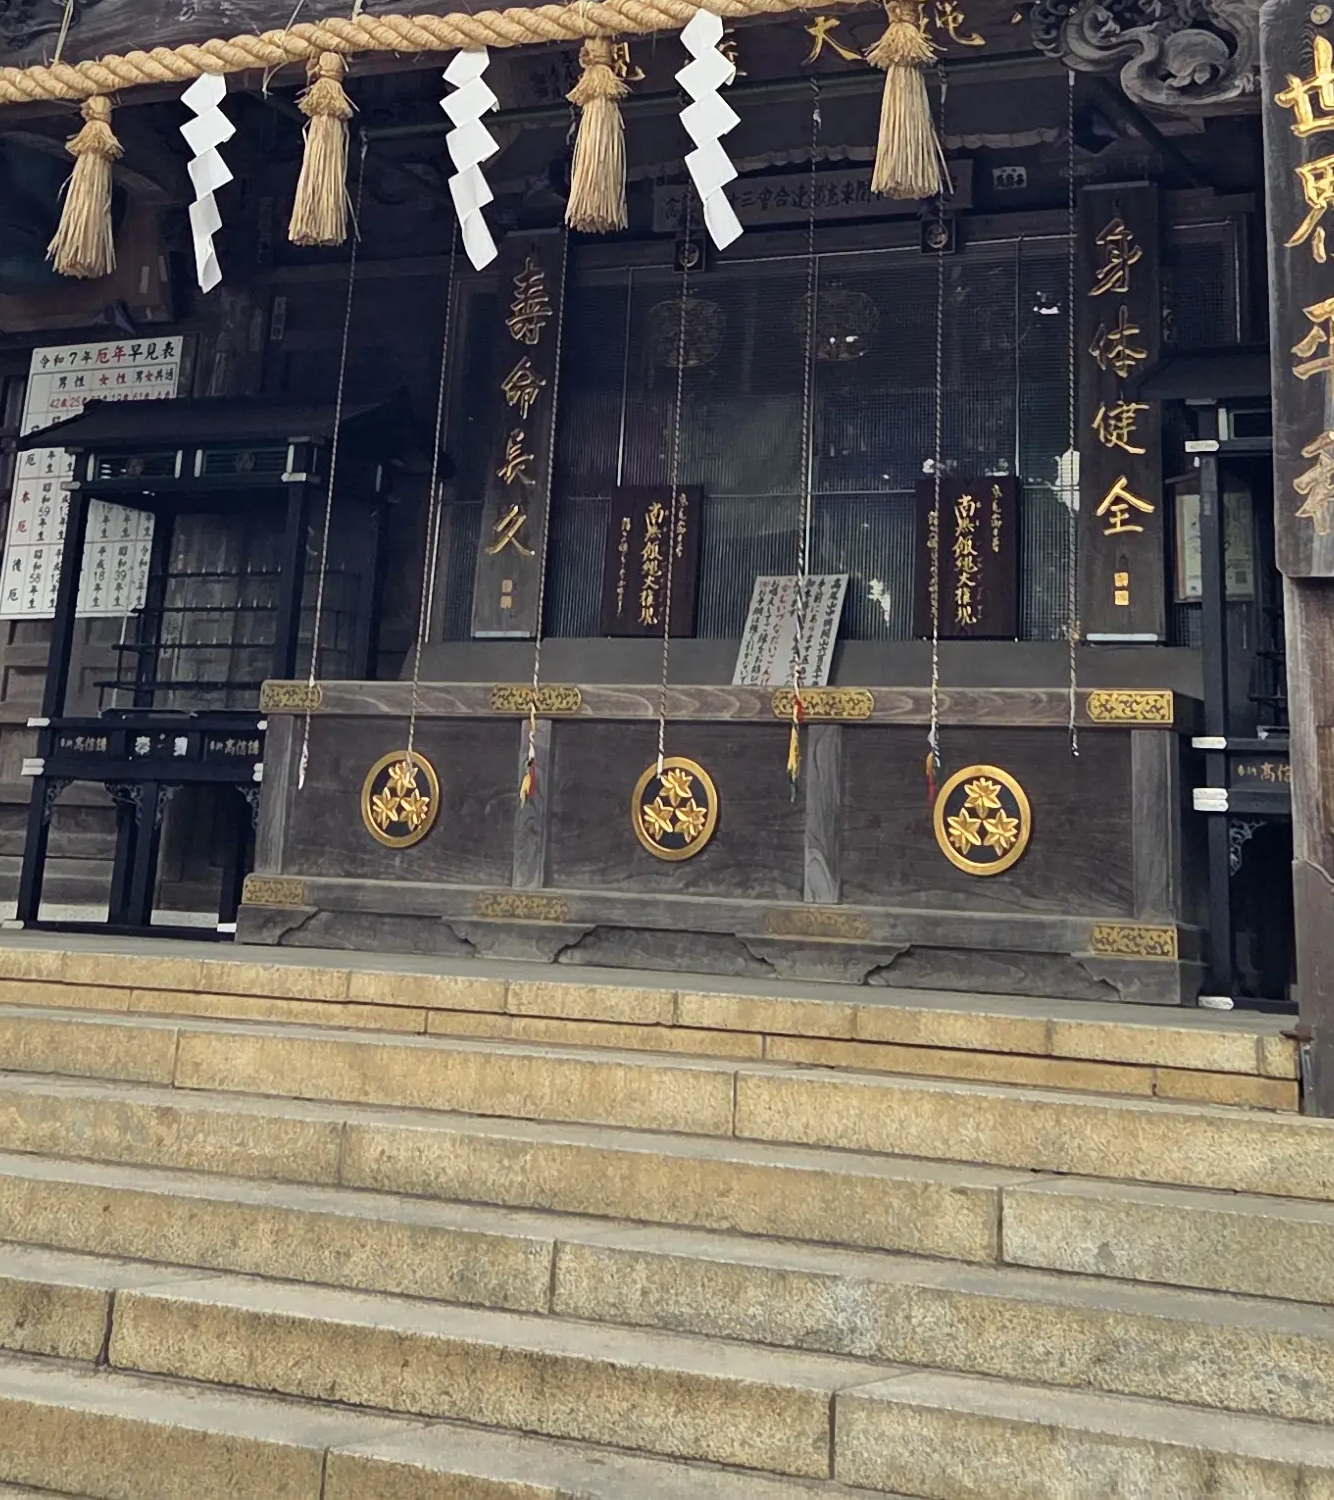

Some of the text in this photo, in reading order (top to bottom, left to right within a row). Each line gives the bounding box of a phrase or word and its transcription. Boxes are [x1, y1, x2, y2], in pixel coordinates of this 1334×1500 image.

[39, 340, 176, 369] 令和7年厄年早見表
[1087, 216, 1155, 537] 身体健全
[36, 482, 53, 542] 昭和59年生
[27, 548, 44, 610] 昭和58年生
[92, 546, 107, 608] 平成18年生
